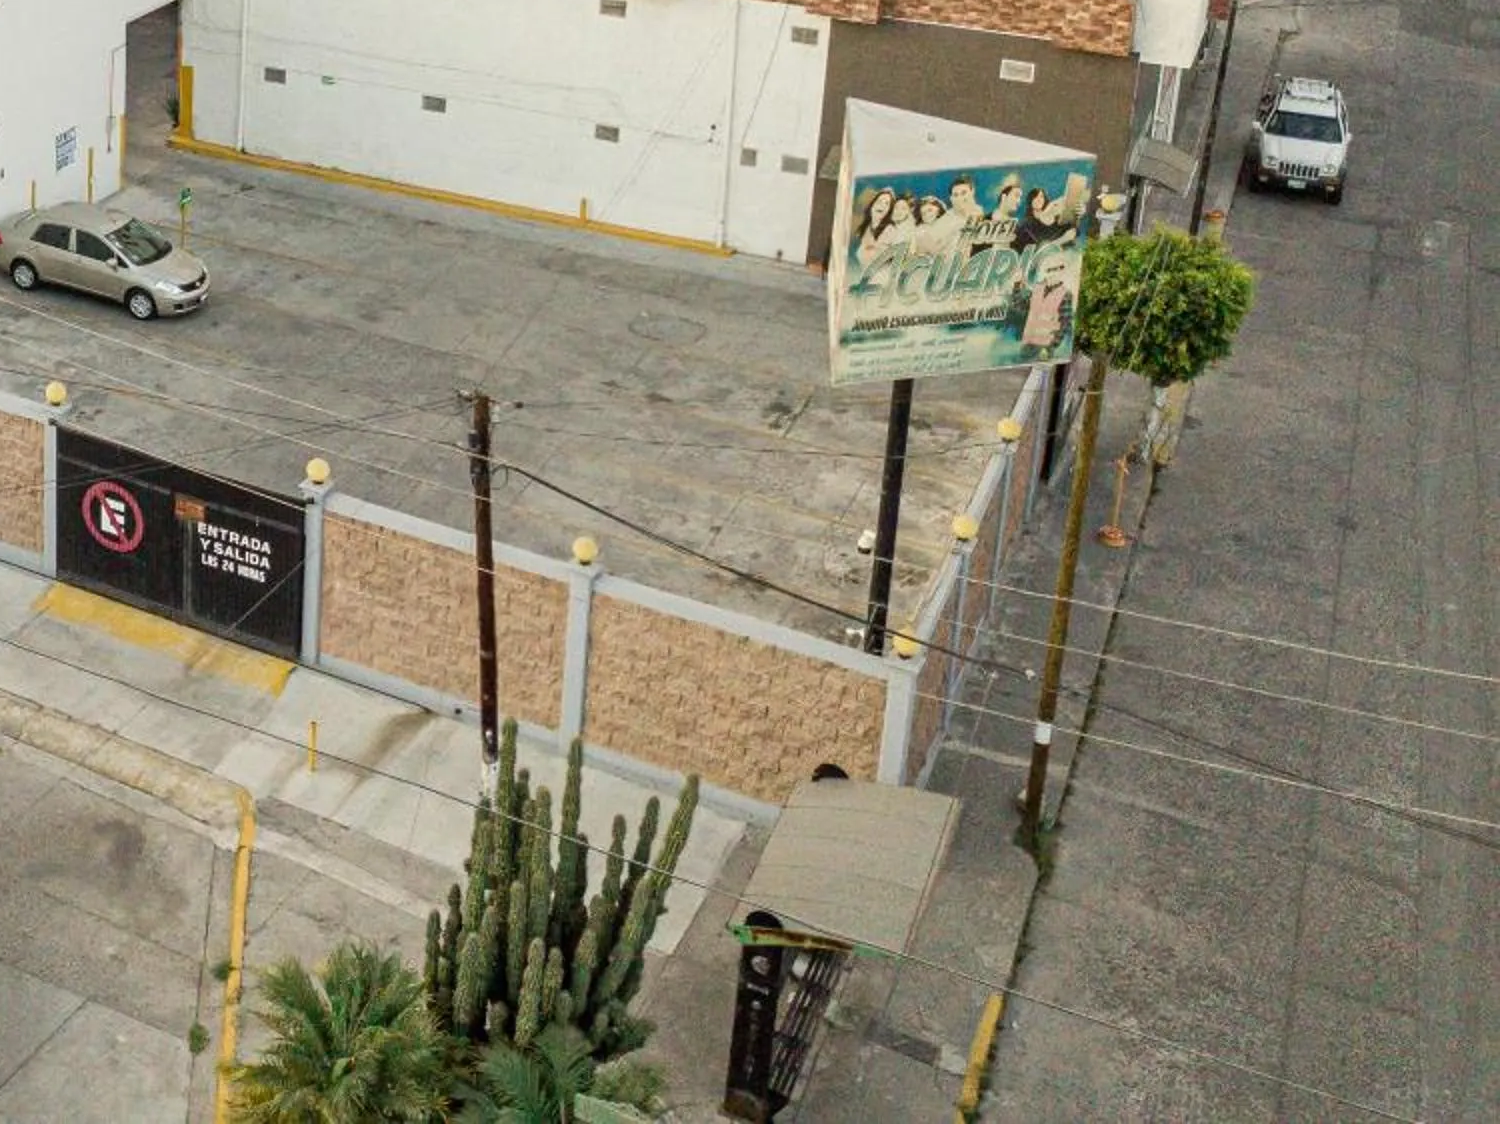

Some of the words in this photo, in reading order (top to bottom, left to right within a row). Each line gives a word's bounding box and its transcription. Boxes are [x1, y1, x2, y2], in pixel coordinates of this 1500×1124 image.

[197, 521, 271, 555] ENTRADA
[200, 538, 211, 553] Y
[213, 544, 270, 570] SALIDA
[222, 558, 235, 575] 24
